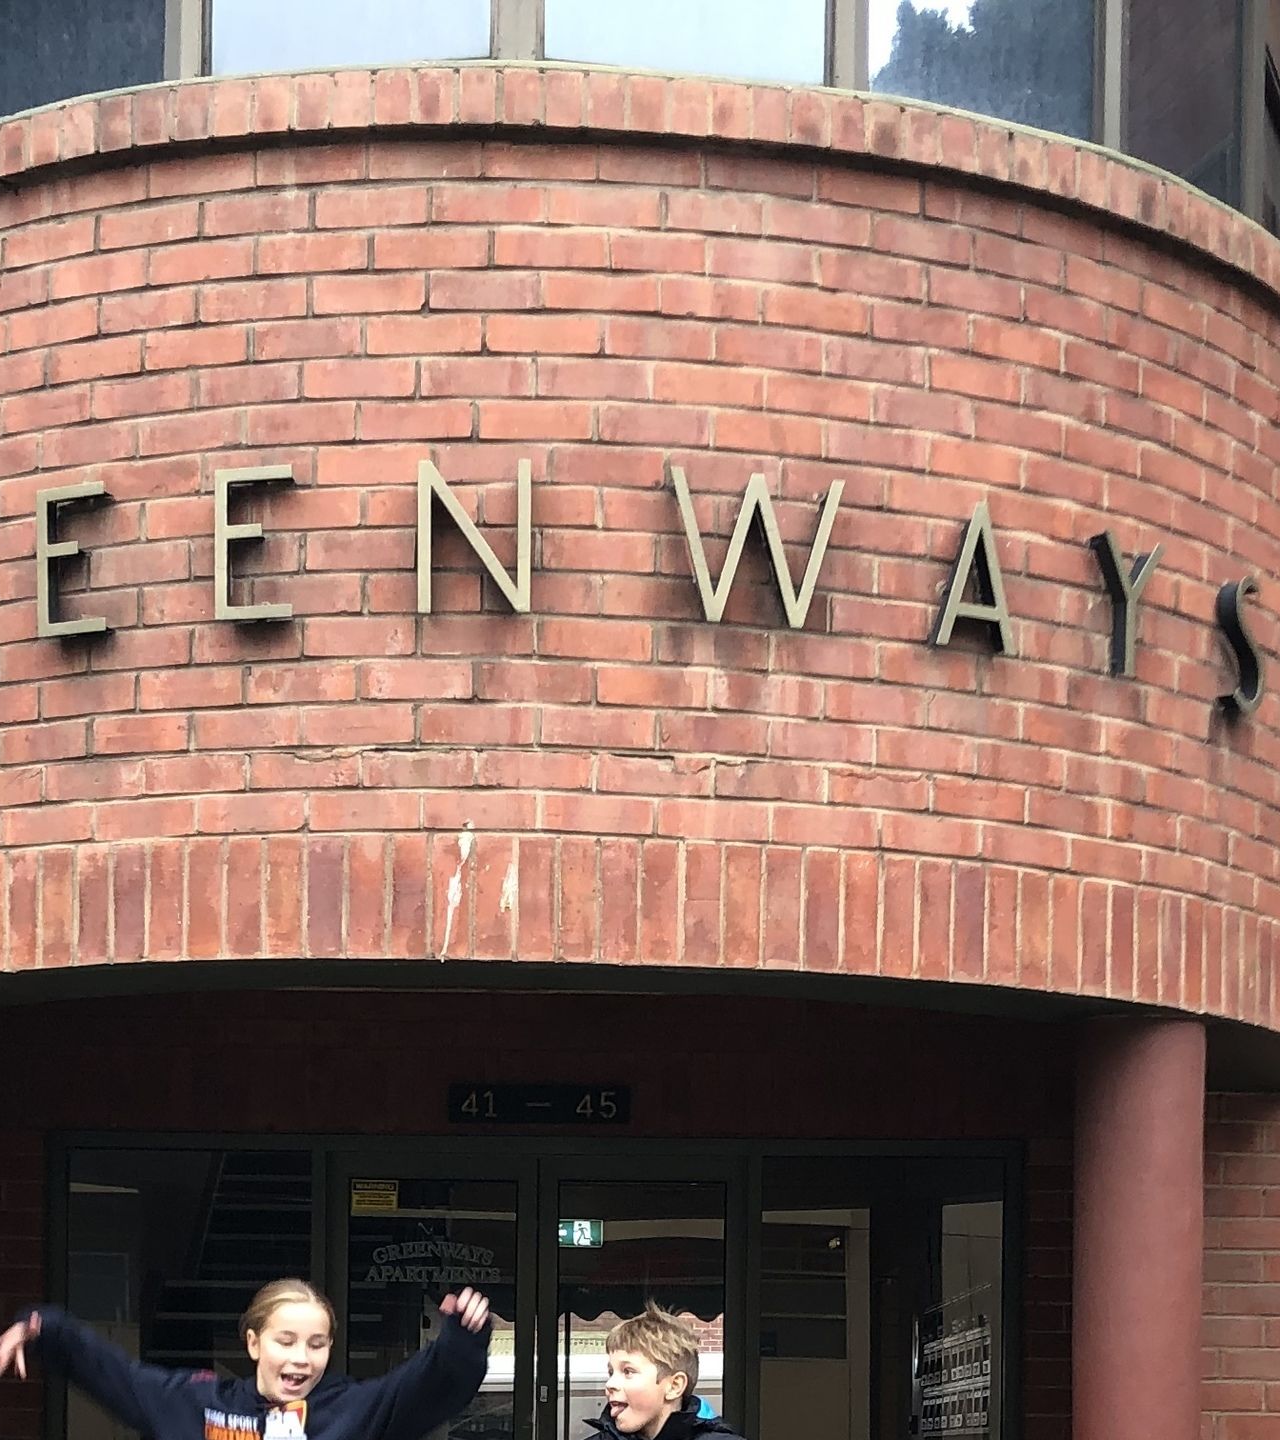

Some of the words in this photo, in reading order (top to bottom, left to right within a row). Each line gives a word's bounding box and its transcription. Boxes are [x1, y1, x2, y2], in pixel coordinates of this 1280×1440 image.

[461, 1090, 497, 1118] 41
[575, 1091, 617, 1119] 45
[372, 1241, 495, 1266] GREENWAYS
[365, 1265, 502, 1284] APARTMENTS
